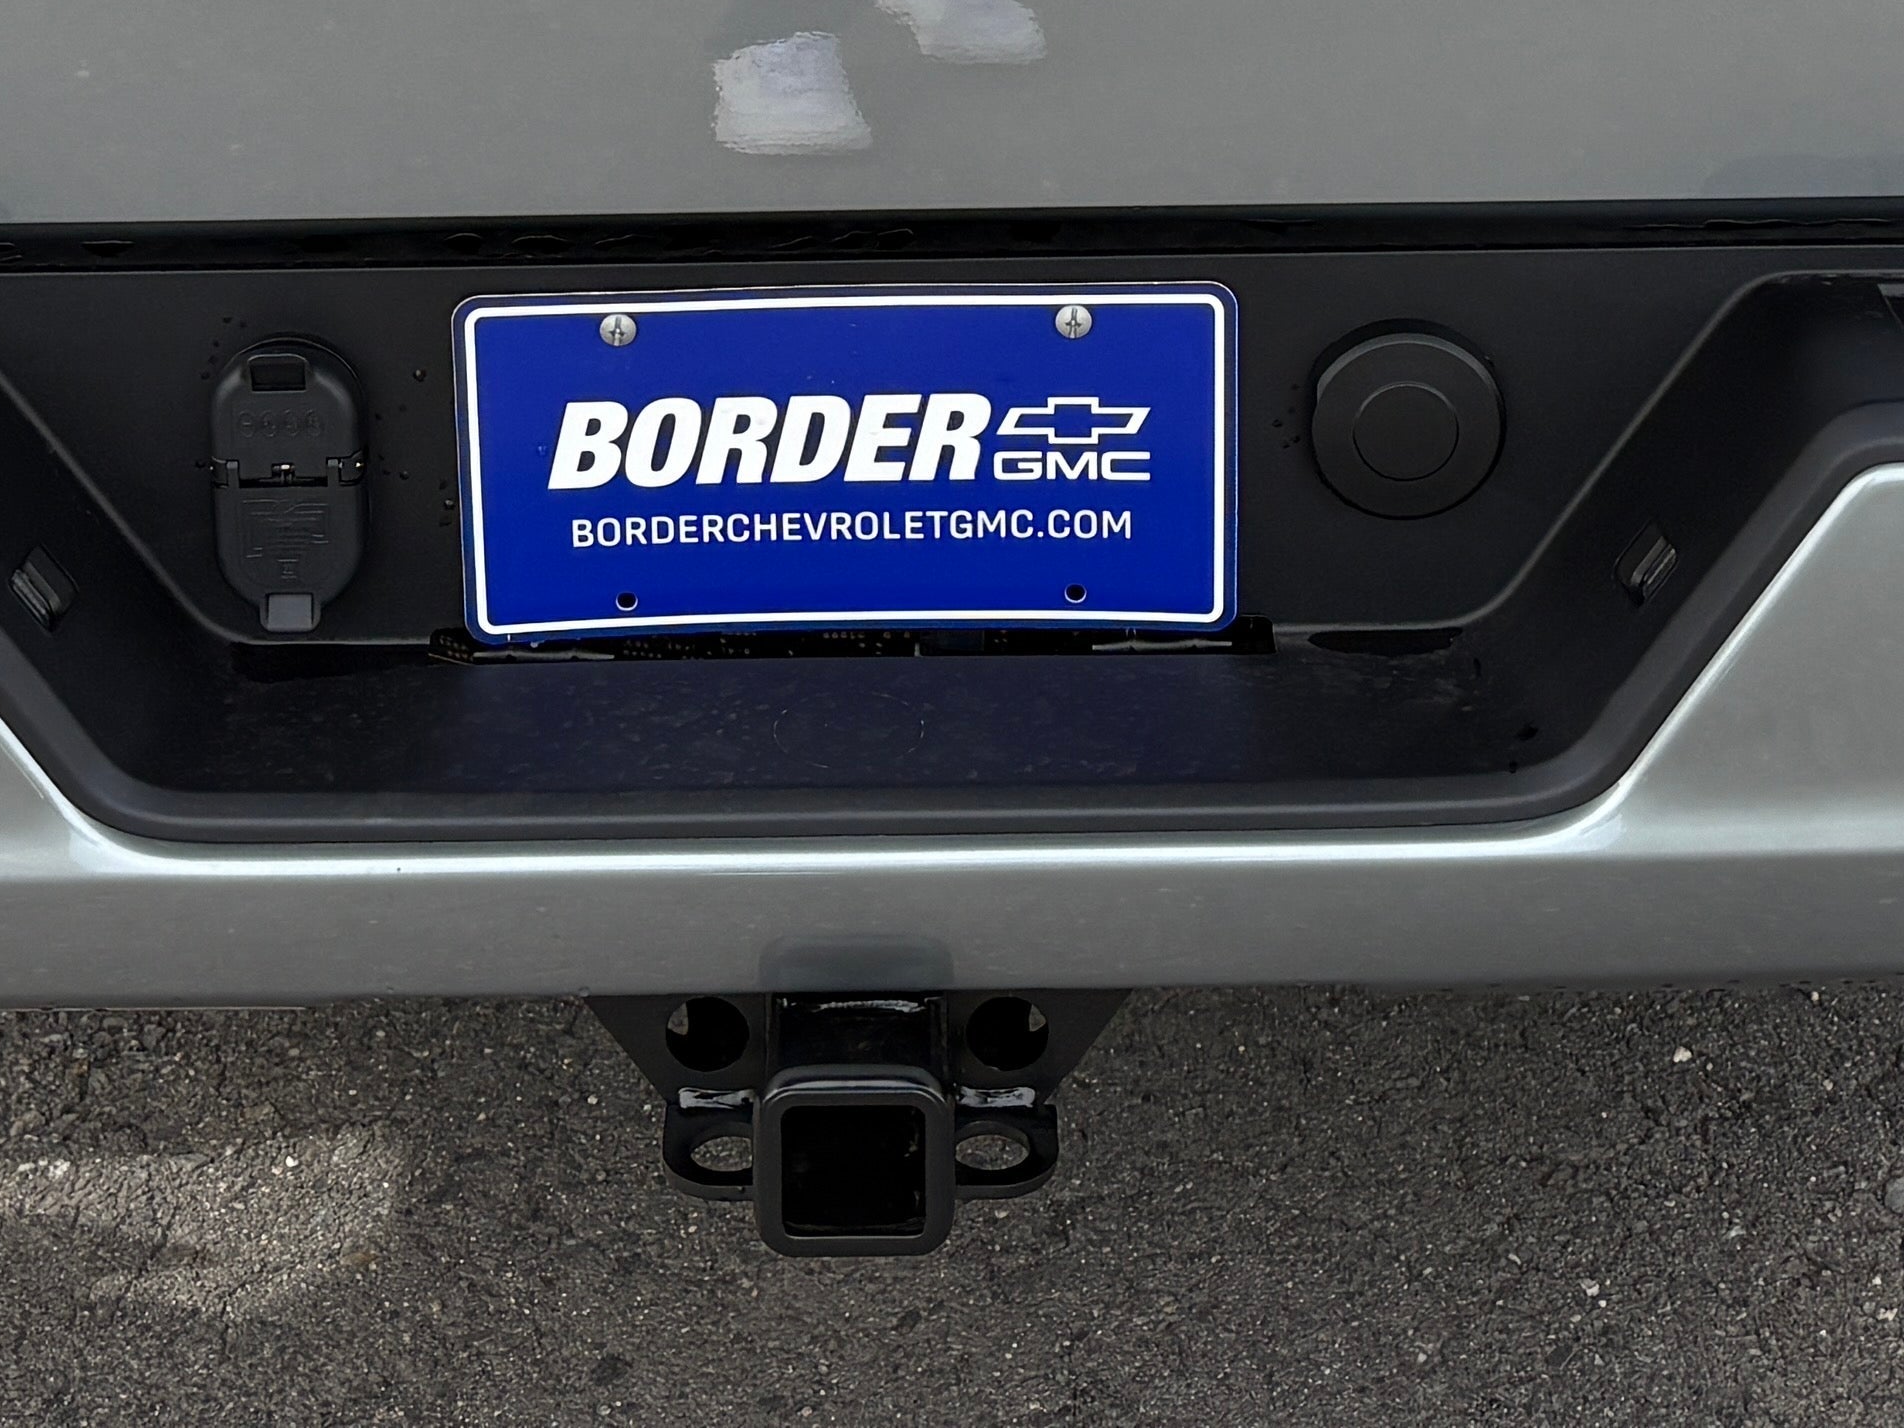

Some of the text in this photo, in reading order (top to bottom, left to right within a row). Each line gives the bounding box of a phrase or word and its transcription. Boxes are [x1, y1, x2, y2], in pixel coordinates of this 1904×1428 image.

[547, 392, 1151, 490] BORDER GMC
[570, 509, 1133, 549] BORDERCHEVROLETGMC.COM
